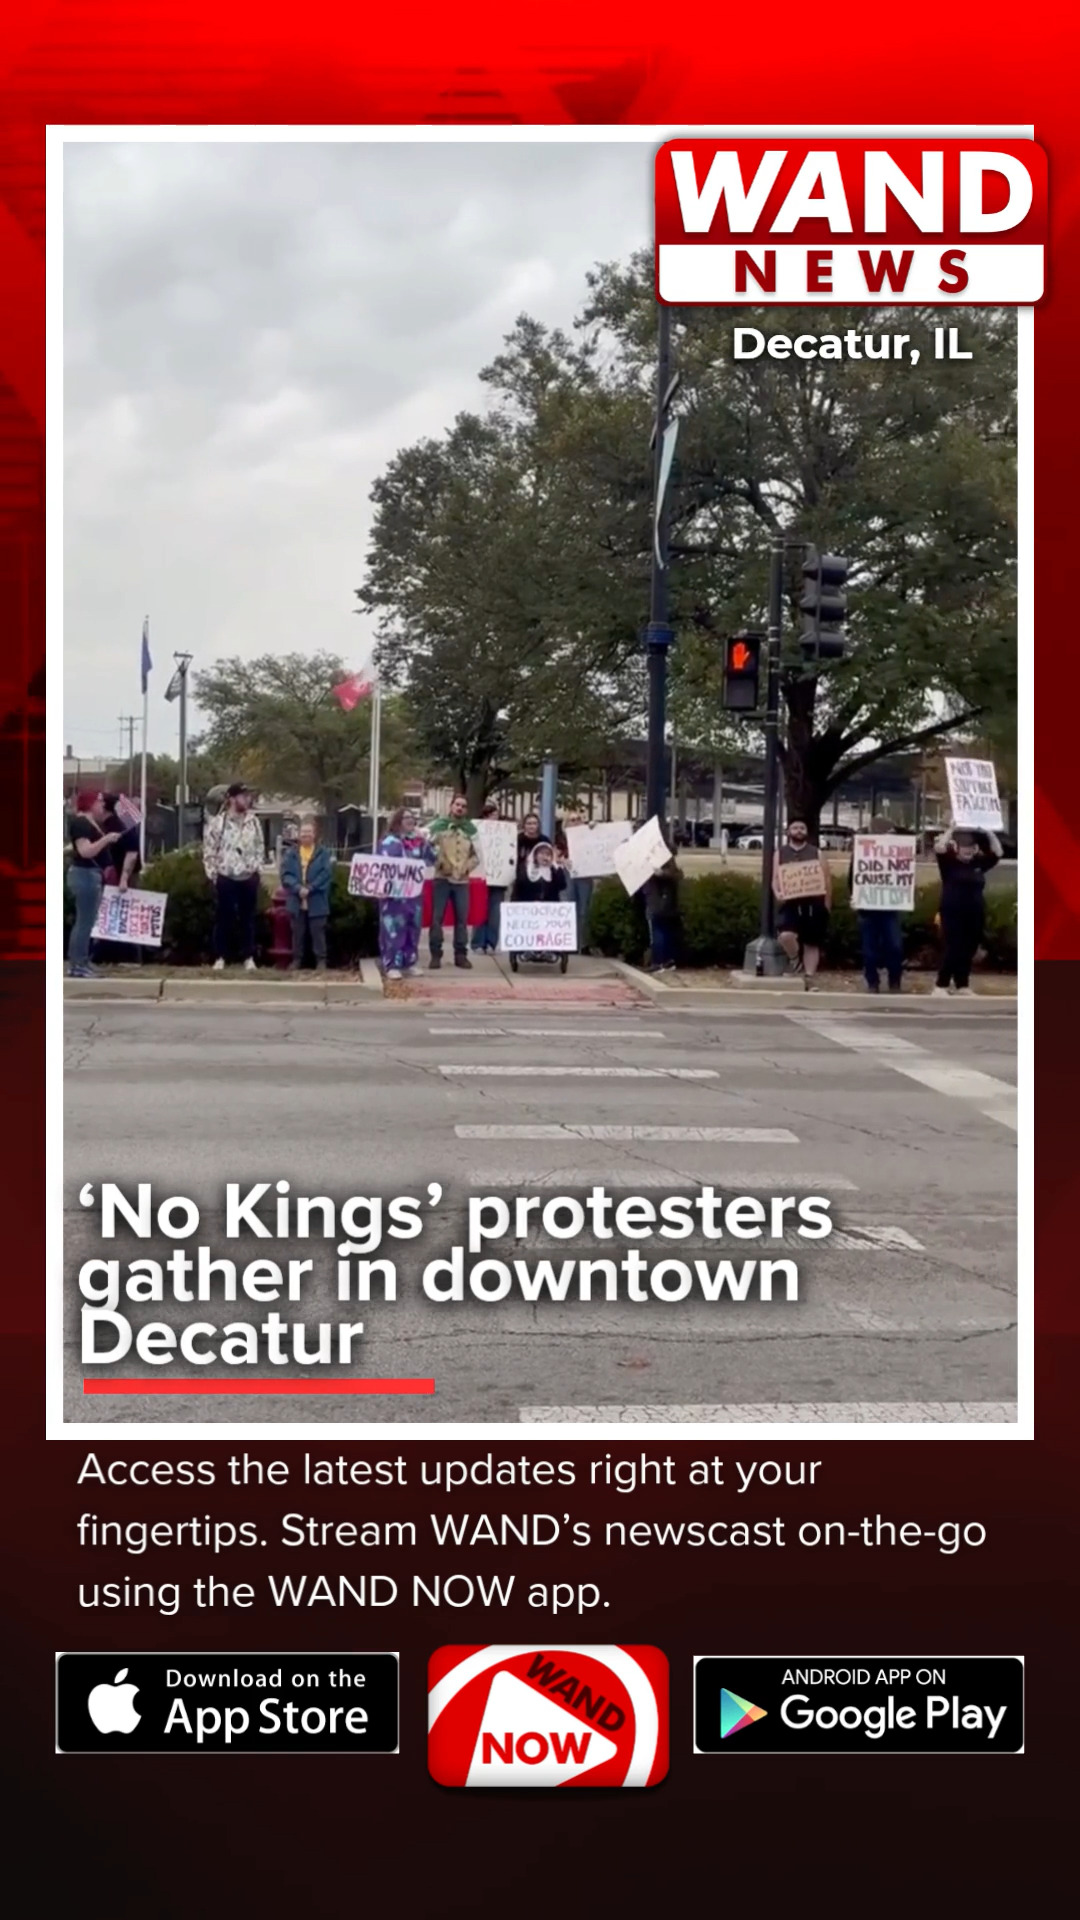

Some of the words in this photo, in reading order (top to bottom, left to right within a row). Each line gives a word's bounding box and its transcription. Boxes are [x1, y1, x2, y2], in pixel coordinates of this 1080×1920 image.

[858, 839, 914, 857] TYLEN
[858, 859, 883, 872] DID
[888, 858, 914, 872] NOT
[354, 863, 369, 878] NO
[369, 863, 424, 884] CROWNS
[855, 873, 893, 886] CAUSE
[897, 873, 914, 886] MY
[506, 905, 573, 918] DEMOCRACY
[506, 919, 540, 931] NEEDS
[544, 919, 572, 930] YOUR
[504, 932, 573, 947] COURAGE
